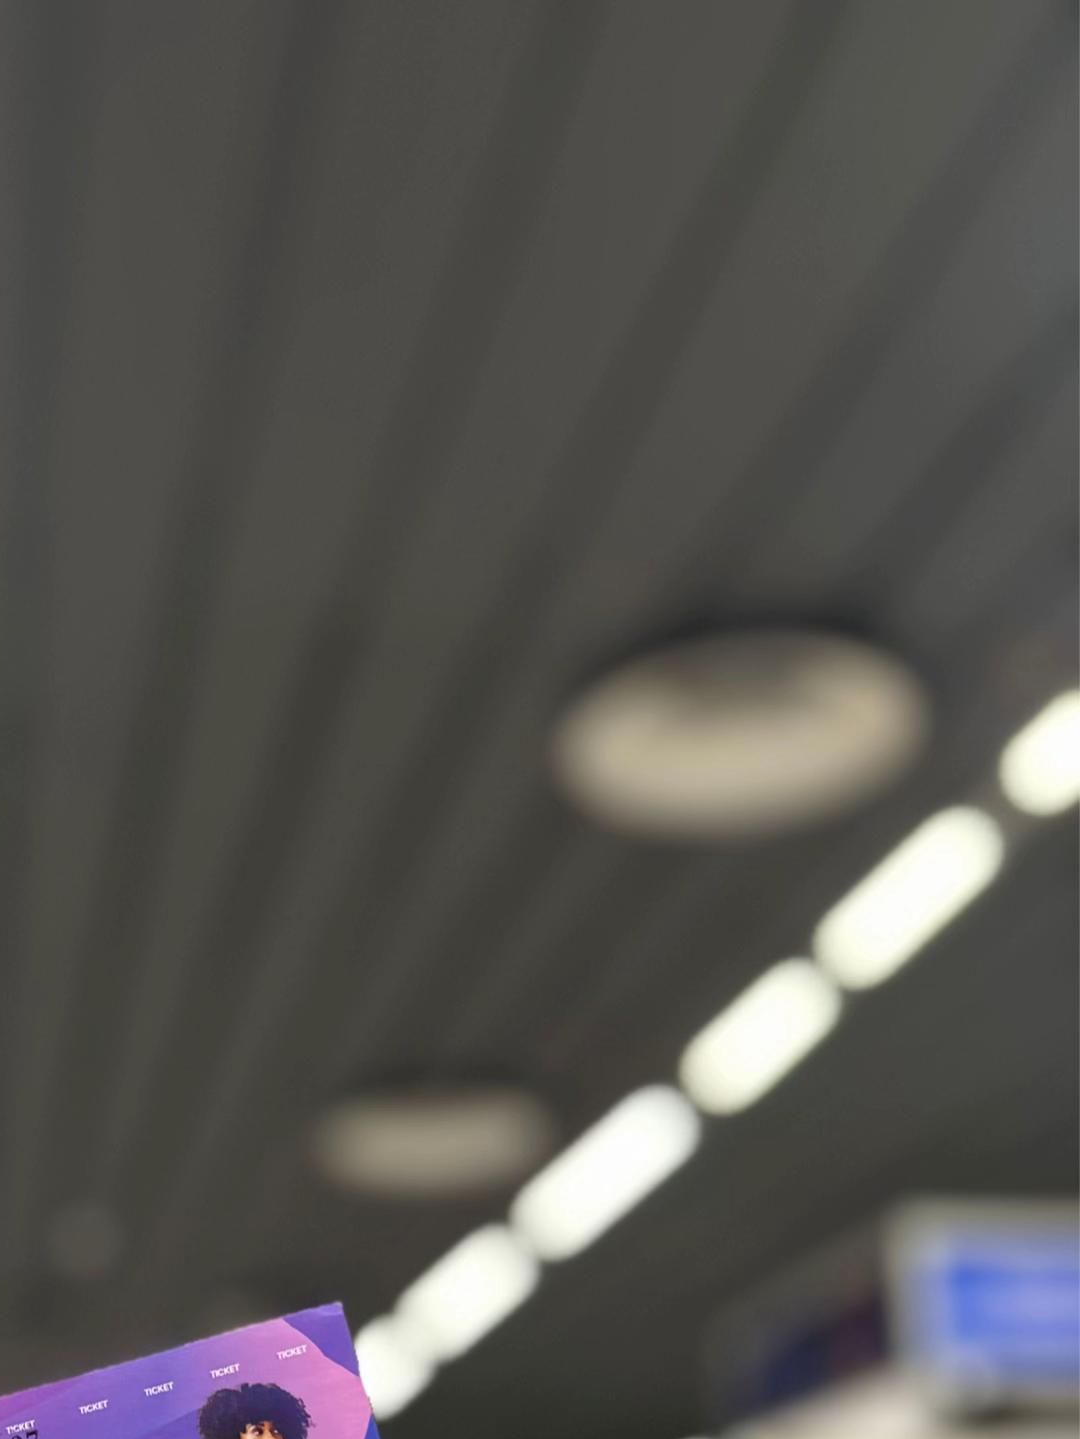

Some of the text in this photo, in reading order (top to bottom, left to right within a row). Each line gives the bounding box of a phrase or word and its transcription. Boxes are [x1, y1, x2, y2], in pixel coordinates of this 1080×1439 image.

[79, 1400, 109, 1415] TICKET
[144, 1381, 174, 1397] TICKET
[209, 1363, 241, 1379] TICKET
[276, 1344, 308, 1360] TICKET
